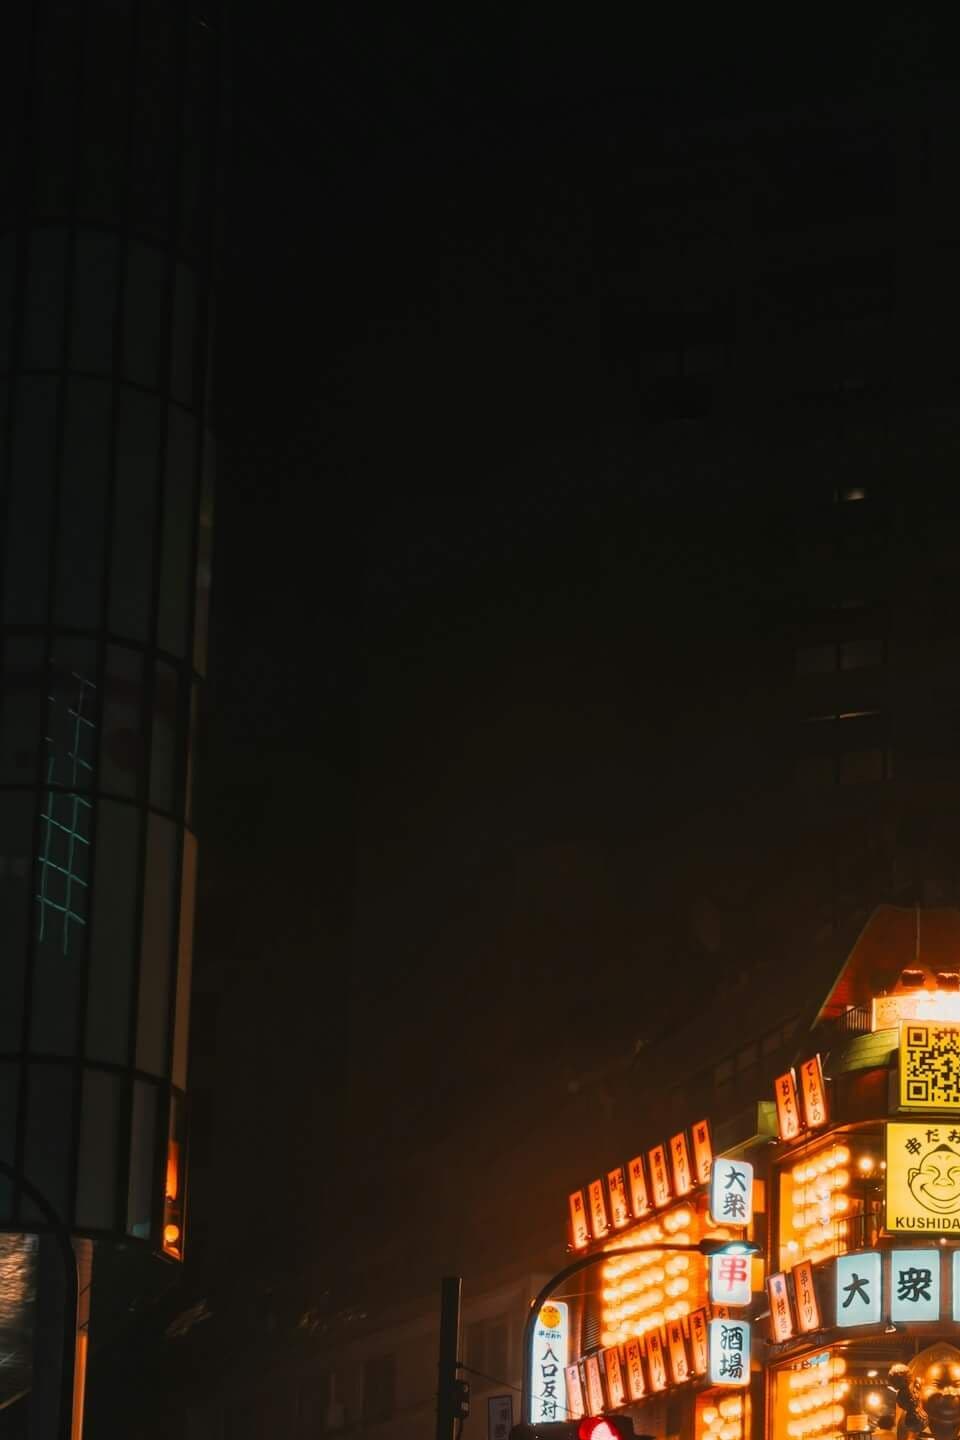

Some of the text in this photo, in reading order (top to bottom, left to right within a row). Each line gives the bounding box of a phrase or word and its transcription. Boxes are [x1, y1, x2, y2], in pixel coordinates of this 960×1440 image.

[723, 1166, 747, 1218] 大衆
[719, 1257, 747, 1291] 串
[719, 1324, 745, 1379] 酒場
[541, 1343, 559, 1419] 入口反対
